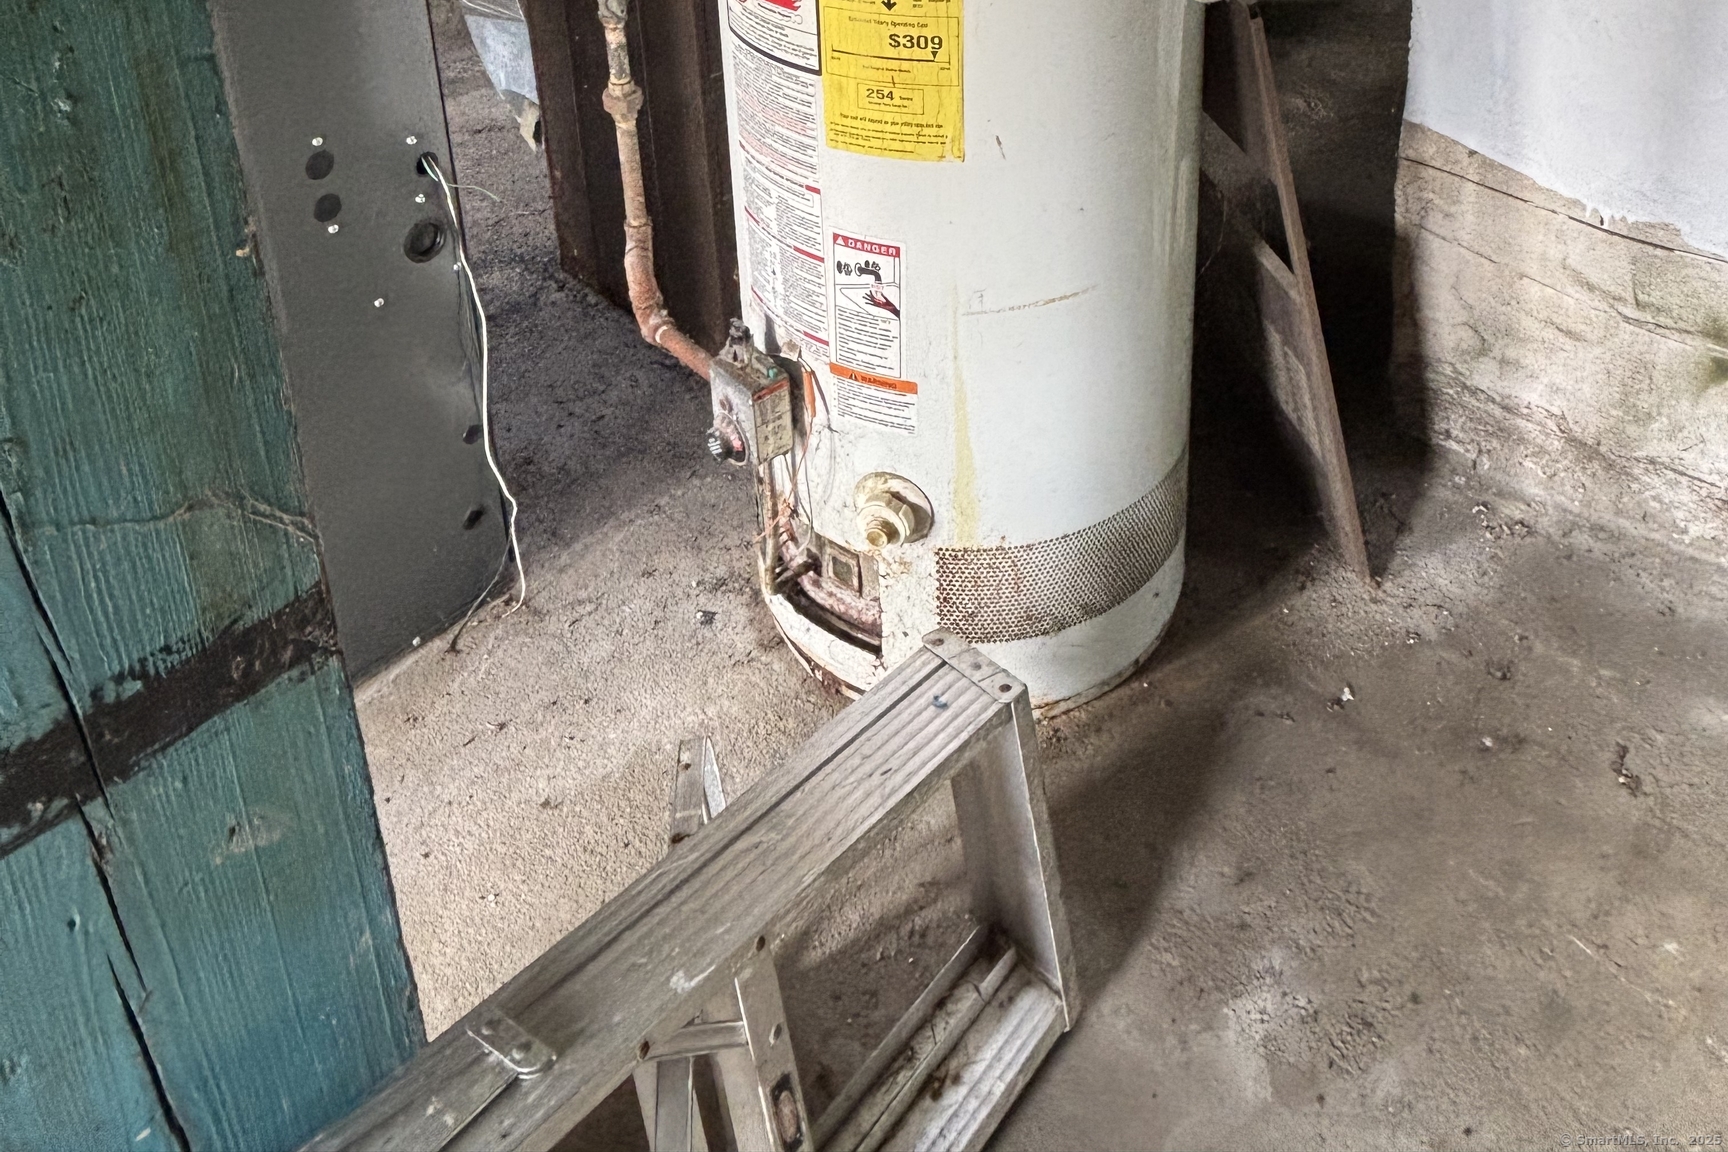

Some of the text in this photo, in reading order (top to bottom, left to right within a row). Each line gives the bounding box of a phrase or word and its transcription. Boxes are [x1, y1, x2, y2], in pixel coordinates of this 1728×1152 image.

[888, 33, 943, 50] $309
[866, 88, 895, 102] 254
[848, 238, 896, 256] DANGER
[860, 374, 897, 390] WARNING
